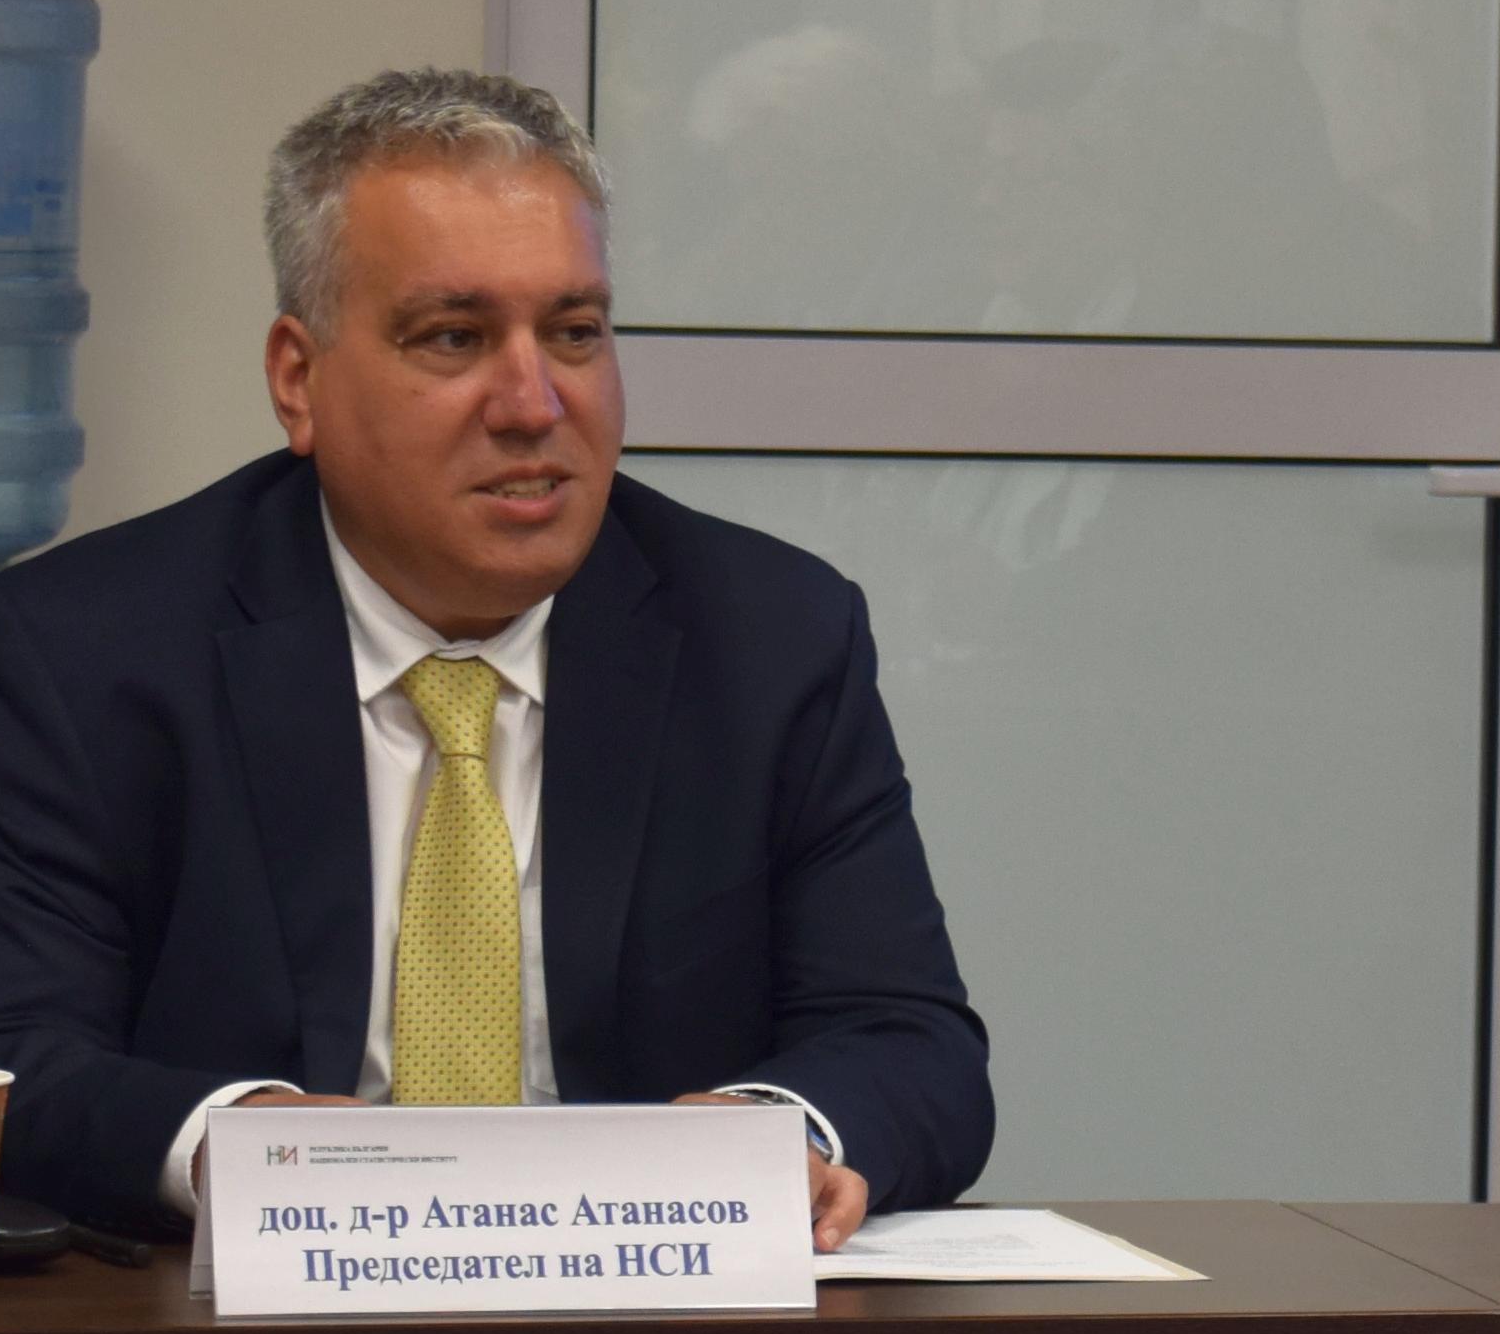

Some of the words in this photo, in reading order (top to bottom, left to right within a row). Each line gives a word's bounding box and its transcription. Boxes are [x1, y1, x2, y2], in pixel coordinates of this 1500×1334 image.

[258, 1201, 338, 1235] доц.
[349, 1199, 409, 1239] д-р
[422, 1195, 559, 1229] Атанас
[570, 1193, 750, 1228] Атанасов
[303, 1246, 548, 1290] Председател
[559, 1252, 605, 1279] на
[615, 1242, 714, 1278] НСИ
